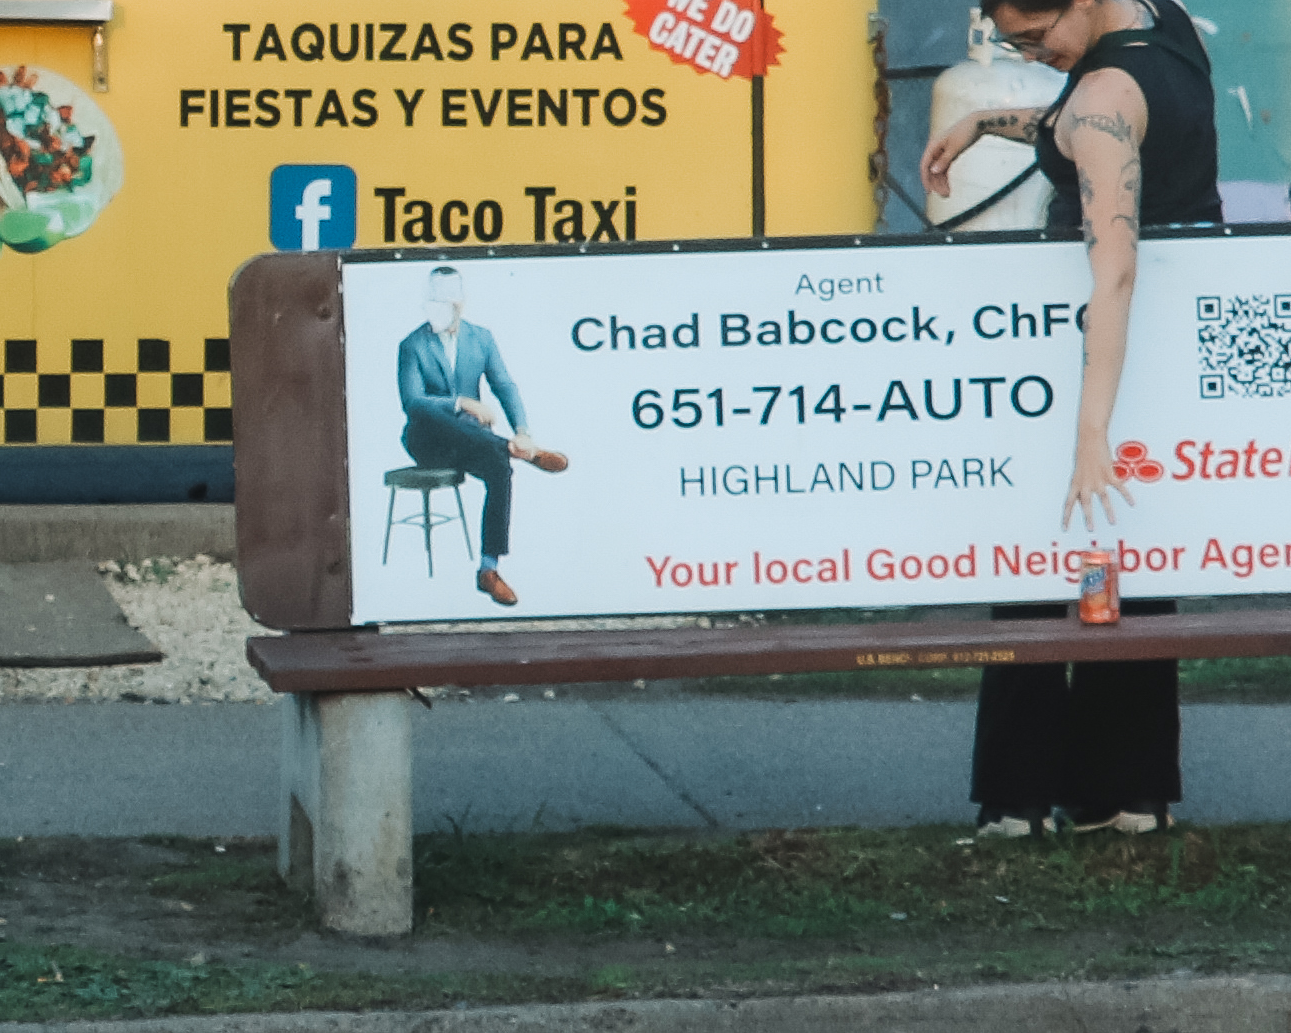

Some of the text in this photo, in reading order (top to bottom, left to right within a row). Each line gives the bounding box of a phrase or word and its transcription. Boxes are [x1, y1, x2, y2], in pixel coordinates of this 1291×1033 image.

[223, 22, 624, 62] TAQUIZAS PARA
[711, 0, 757, 44] DO
[649, 11, 741, 79] CATER
[179, 88, 668, 128] FIESTAS Y EVENTOS
[374, 187, 504, 243] Taco
[524, 186, 637, 242] Taxi
[794, 273, 884, 299] Agent
[570, 312, 701, 352] Chad
[719, 303, 957, 347] Babcock,
[631, 375, 1054, 431] 651-714-AUTO
[680, 457, 1014, 496] HIGHLAND PARK
[1172, 440, 1291, 480] State
[646, 552, 739, 589] Your
[753, 549, 851, 584] local
[866, 544, 975, 582] Good
[993, 538, 1186, 583] Neigbor
[1200, 537, 1291, 579] Age
